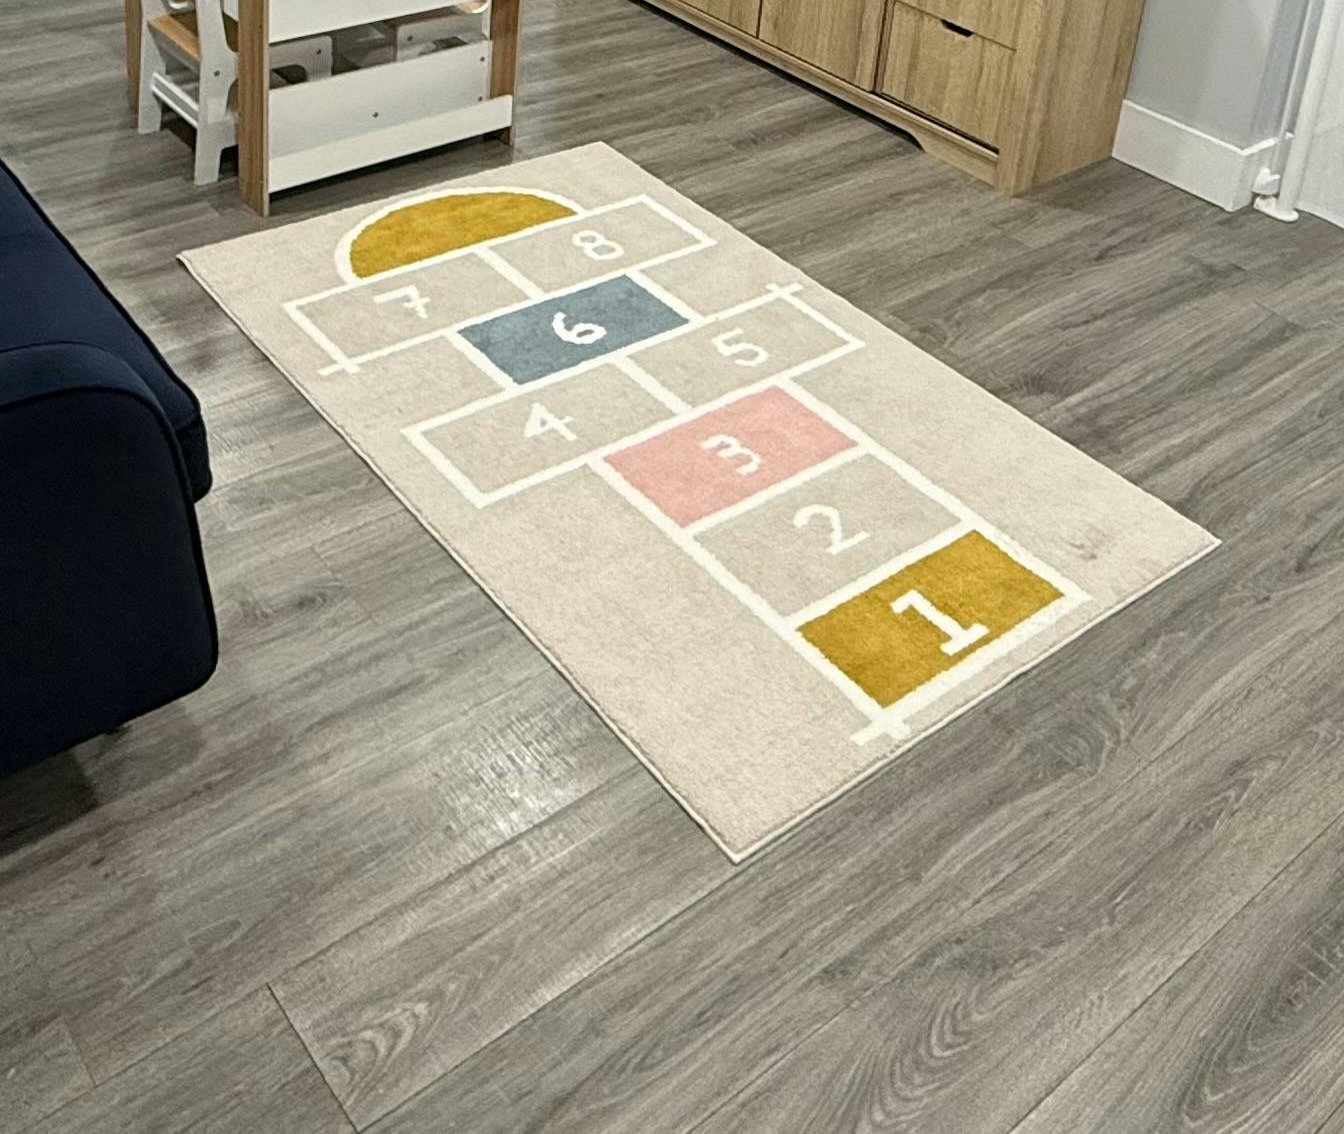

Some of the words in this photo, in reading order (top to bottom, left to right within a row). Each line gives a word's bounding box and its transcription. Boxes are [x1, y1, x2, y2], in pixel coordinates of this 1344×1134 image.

[572, 229, 625, 261] 8
[373, 285, 432, 319] 7
[551, 311, 608, 345] 6
[711, 328, 769, 367] 5
[524, 403, 578, 442] 4
[700, 433, 762, 476] 3
[792, 504, 871, 556] 2
[891, 589, 990, 656] 1
